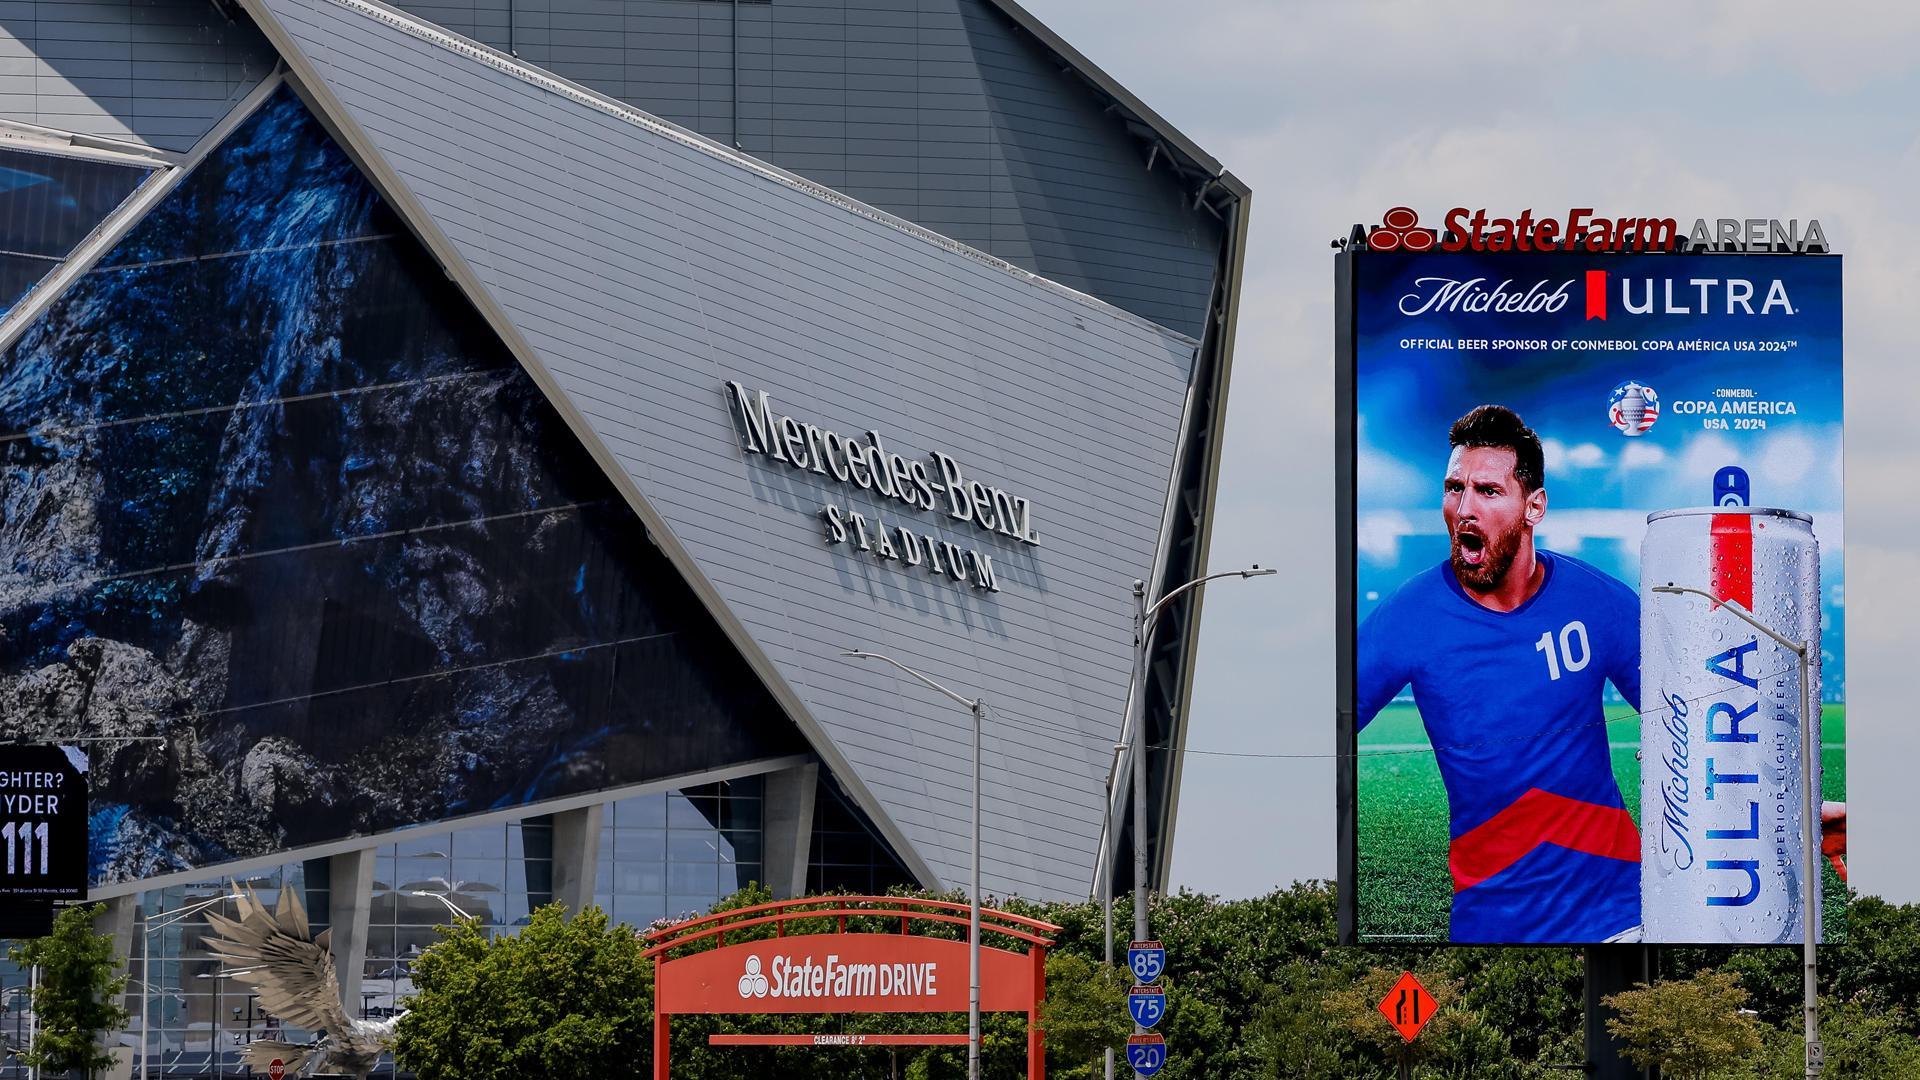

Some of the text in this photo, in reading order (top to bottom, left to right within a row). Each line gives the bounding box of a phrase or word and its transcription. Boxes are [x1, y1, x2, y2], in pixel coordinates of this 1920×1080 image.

[1685, 218, 1829, 253] ARENA
[1399, 277, 1793, 316] Michelob ULTRA
[1400, 339, 1454, 350] OFFICIAL
[1458, 339, 1488, 350] BEER
[1491, 339, 1548, 350] SPONSOR
[1551, 340, 1568, 350] OF
[1570, 340, 1638, 351] CONMEBOL
[1641, 340, 1674, 351] COPA
[1677, 338, 1730, 351] AMÉRICA
[1733, 341, 1756, 351] USA
[1672, 400, 1797, 415] COPA AMERICA
[1703, 418, 1766, 430] USA 2024
[726, 380, 1041, 547] Mercedes-Benz
[818, 503, 1000, 593] STADIUM
[1535, 620, 1591, 681] 10
[1661, 687, 1694, 870] Michelob
[1705, 639, 1761, 907] ULTRA
[1775, 679, 1786, 877] SUPERIOR LIGHT BEER
[0, 794, 58, 815] YDER
[1, 821, 49, 875] 111
[879, 962, 937, 996] DRIVE
[1134, 953, 1161, 977] 85
[1134, 1000, 1160, 1019] 75
[813, 1035, 850, 1045] CLEARANCE
[270, 1065, 284, 1074] STOP
[1134, 1048, 1161, 1068] 20
